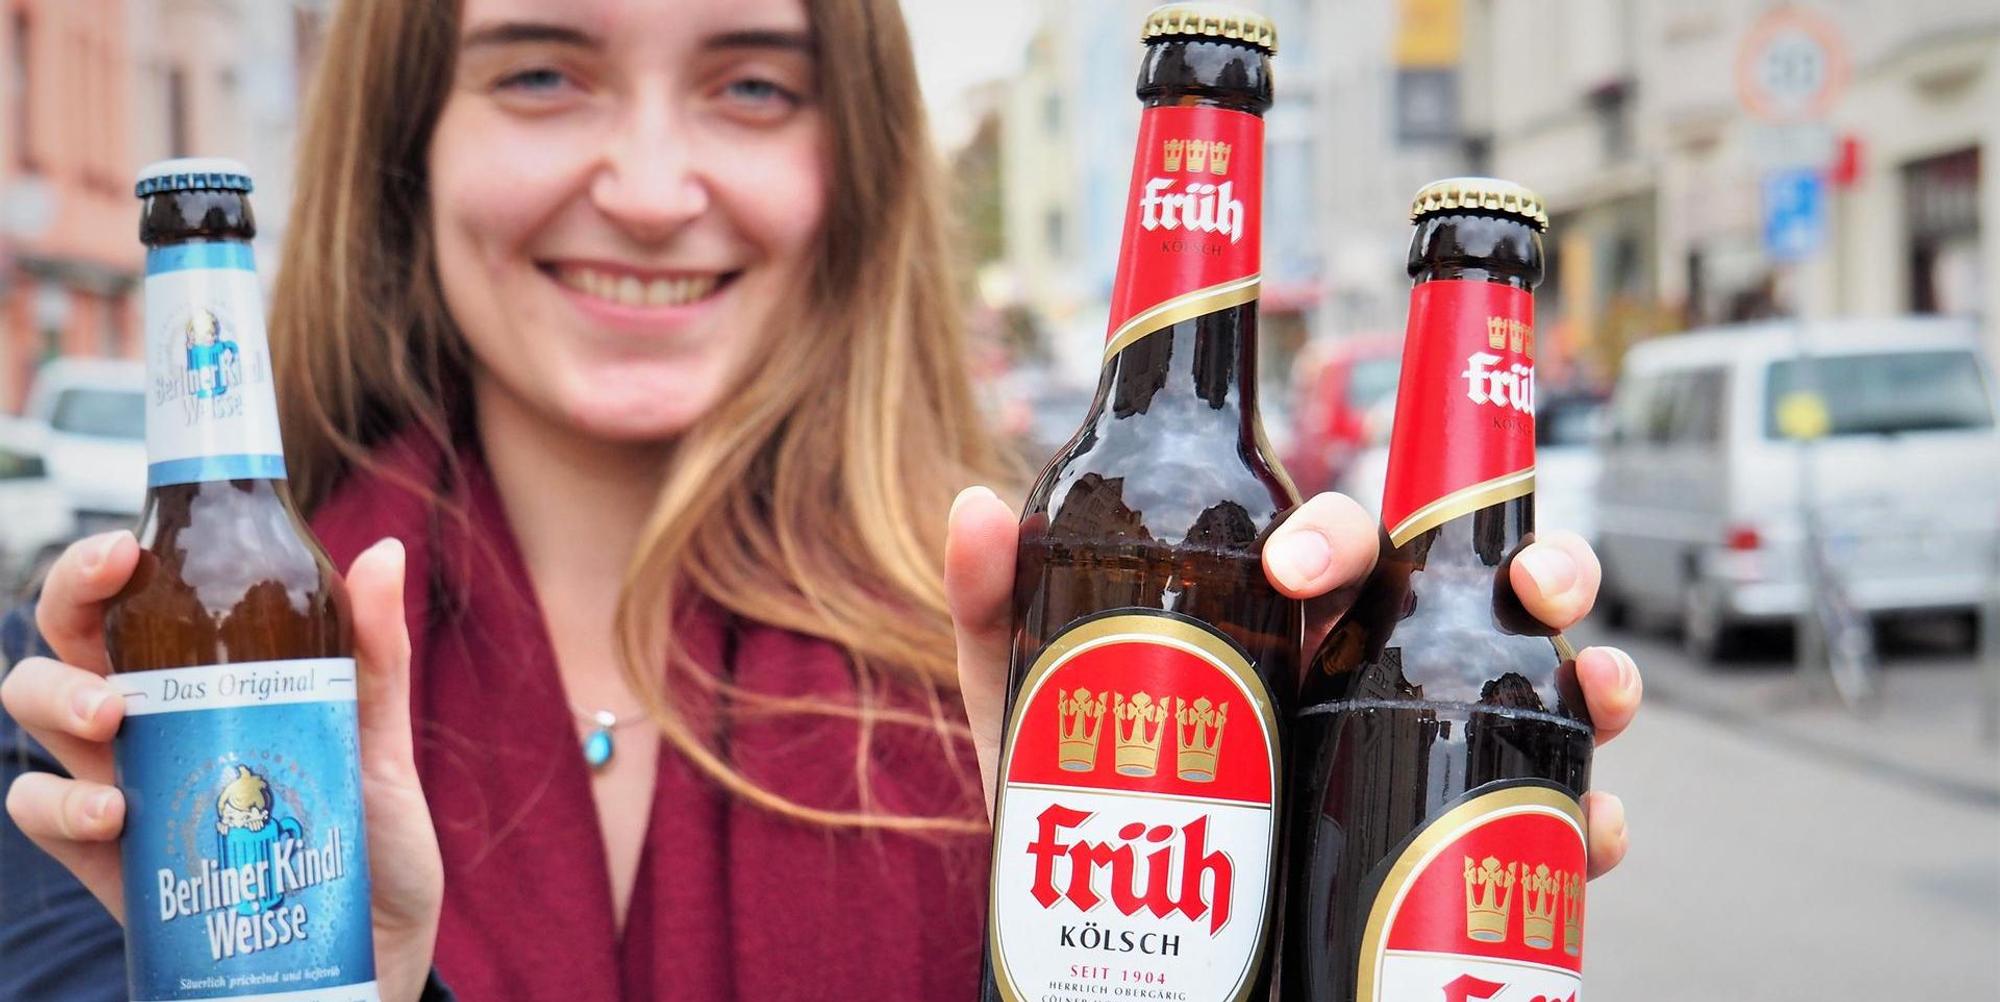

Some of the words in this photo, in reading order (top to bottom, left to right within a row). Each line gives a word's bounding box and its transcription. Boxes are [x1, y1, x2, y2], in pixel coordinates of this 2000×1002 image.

[161, 679, 206, 701] Das
[217, 668, 316, 700] Original
[158, 858, 269, 922] Berliner
[274, 825, 344, 894] Kindl
[206, 902, 308, 961] Weisse
[1060, 921, 1181, 957] KÖLSCH
[282, 970, 301, 983] und
[1049, 981, 1108, 995] HERRLICH
[1070, 964, 1110, 981] SEIT
[1121, 969, 1167, 985] 1904
